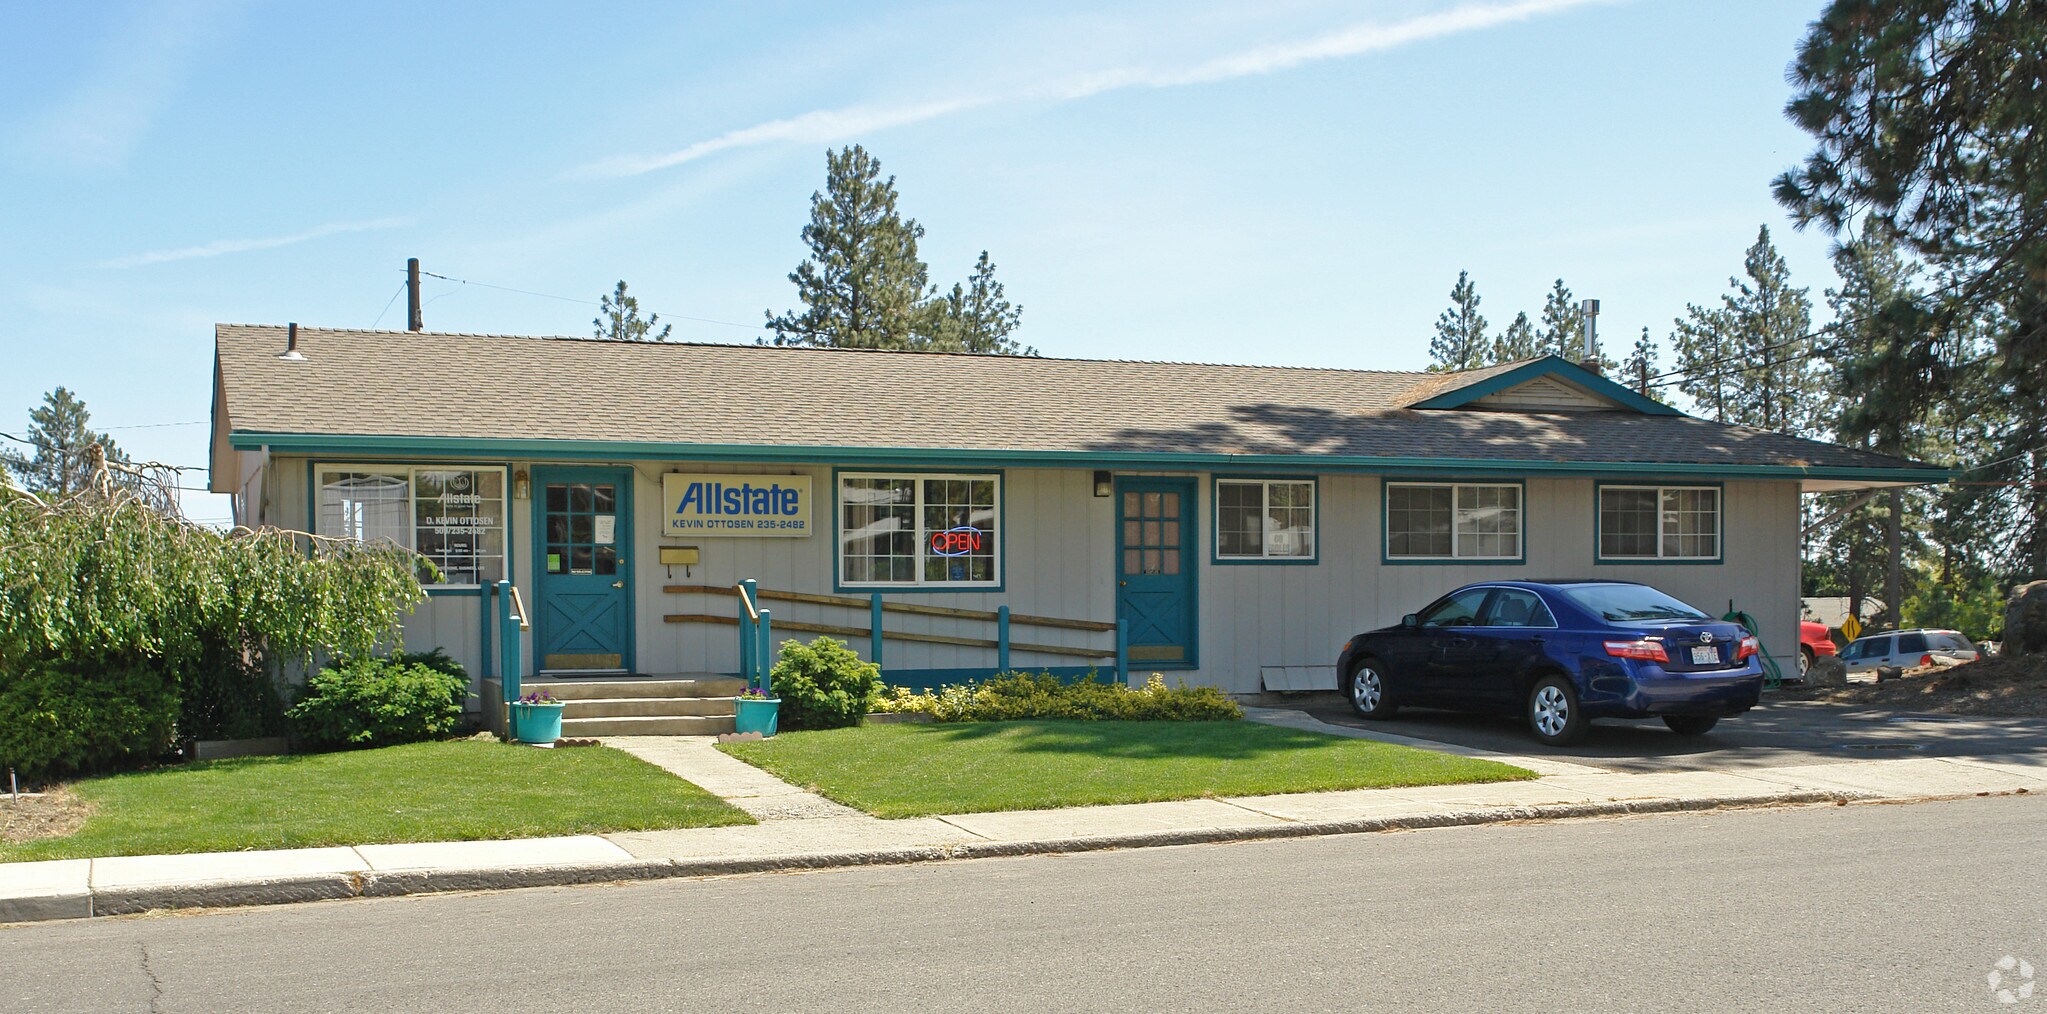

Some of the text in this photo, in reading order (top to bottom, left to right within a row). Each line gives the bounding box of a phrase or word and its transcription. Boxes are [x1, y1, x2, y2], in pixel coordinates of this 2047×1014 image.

[437, 493, 481, 504] Allstate
[676, 482, 799, 516] Allstate
[426, 516, 494, 525] D. KEVIN OTTOSEN
[672, 519, 805, 529] KEVIN OTTOSEN 235-2482
[931, 532, 982, 551] OPEN
